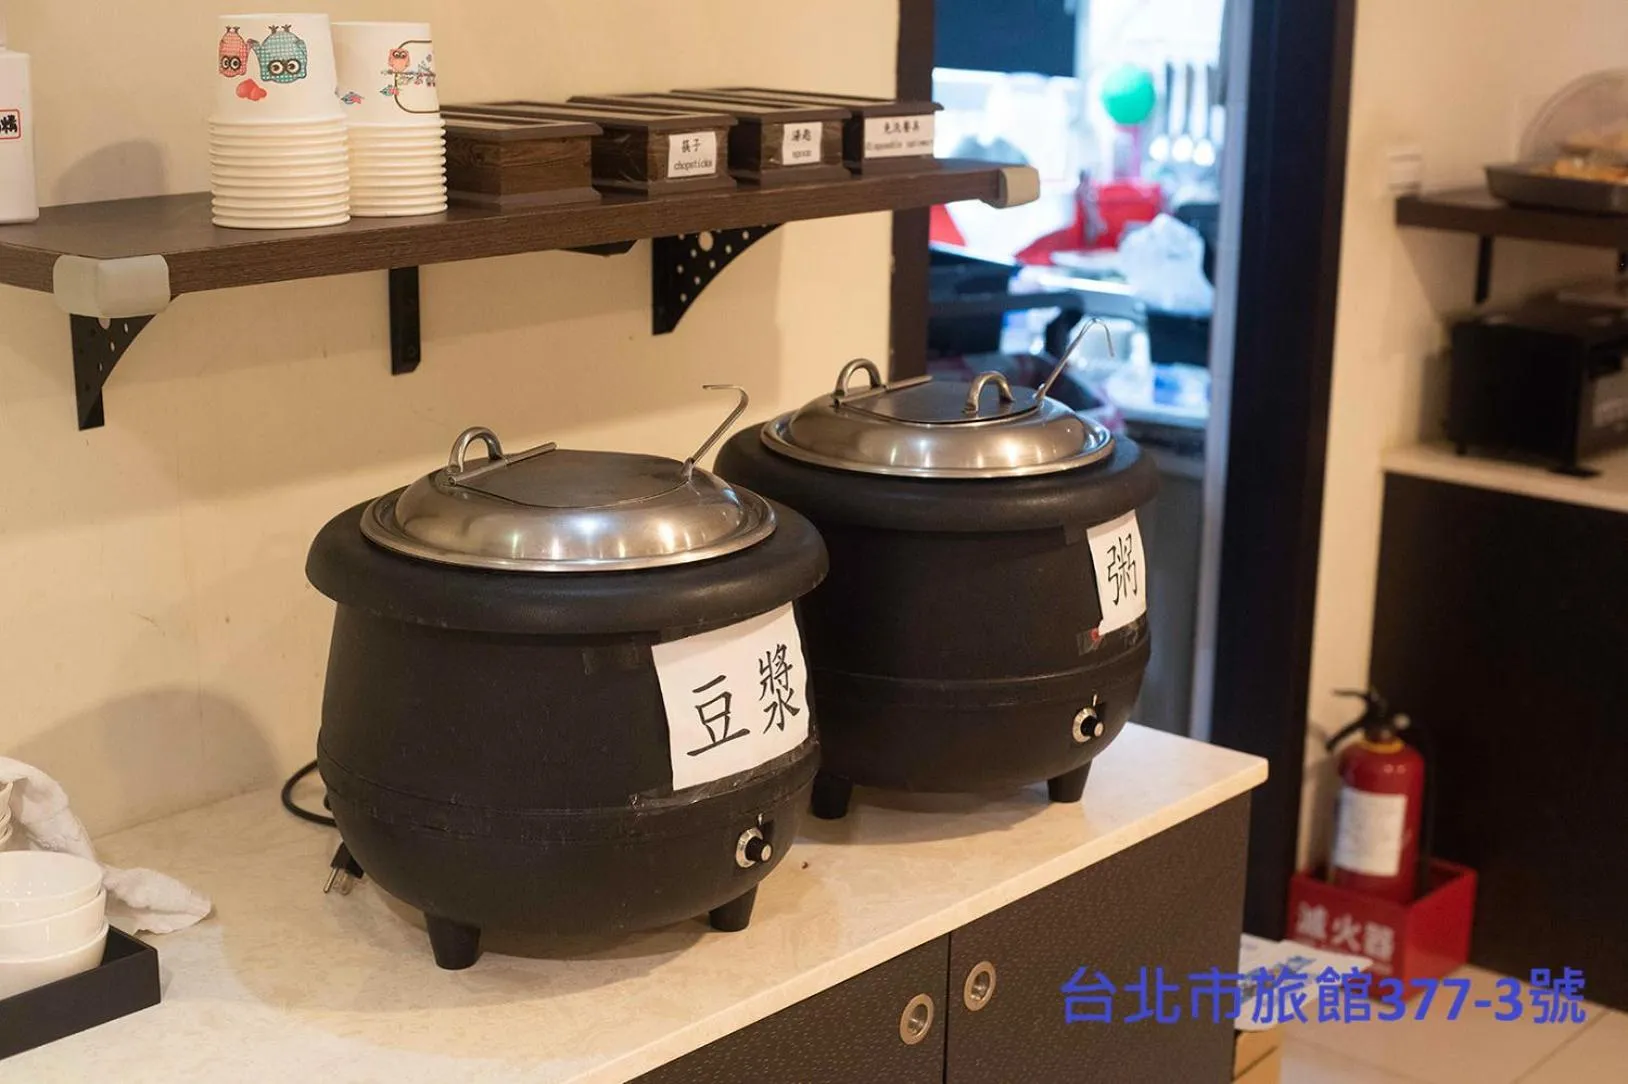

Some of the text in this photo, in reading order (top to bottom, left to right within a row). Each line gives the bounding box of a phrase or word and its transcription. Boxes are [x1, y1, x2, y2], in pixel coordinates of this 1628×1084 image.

[674, 160, 713, 171] chopsticks
[681, 138, 702, 153] 筷子
[1106, 533, 1138, 606] 粥
[686, 643, 801, 757] 豆漿
[1296, 900, 1395, 963] 滅火器
